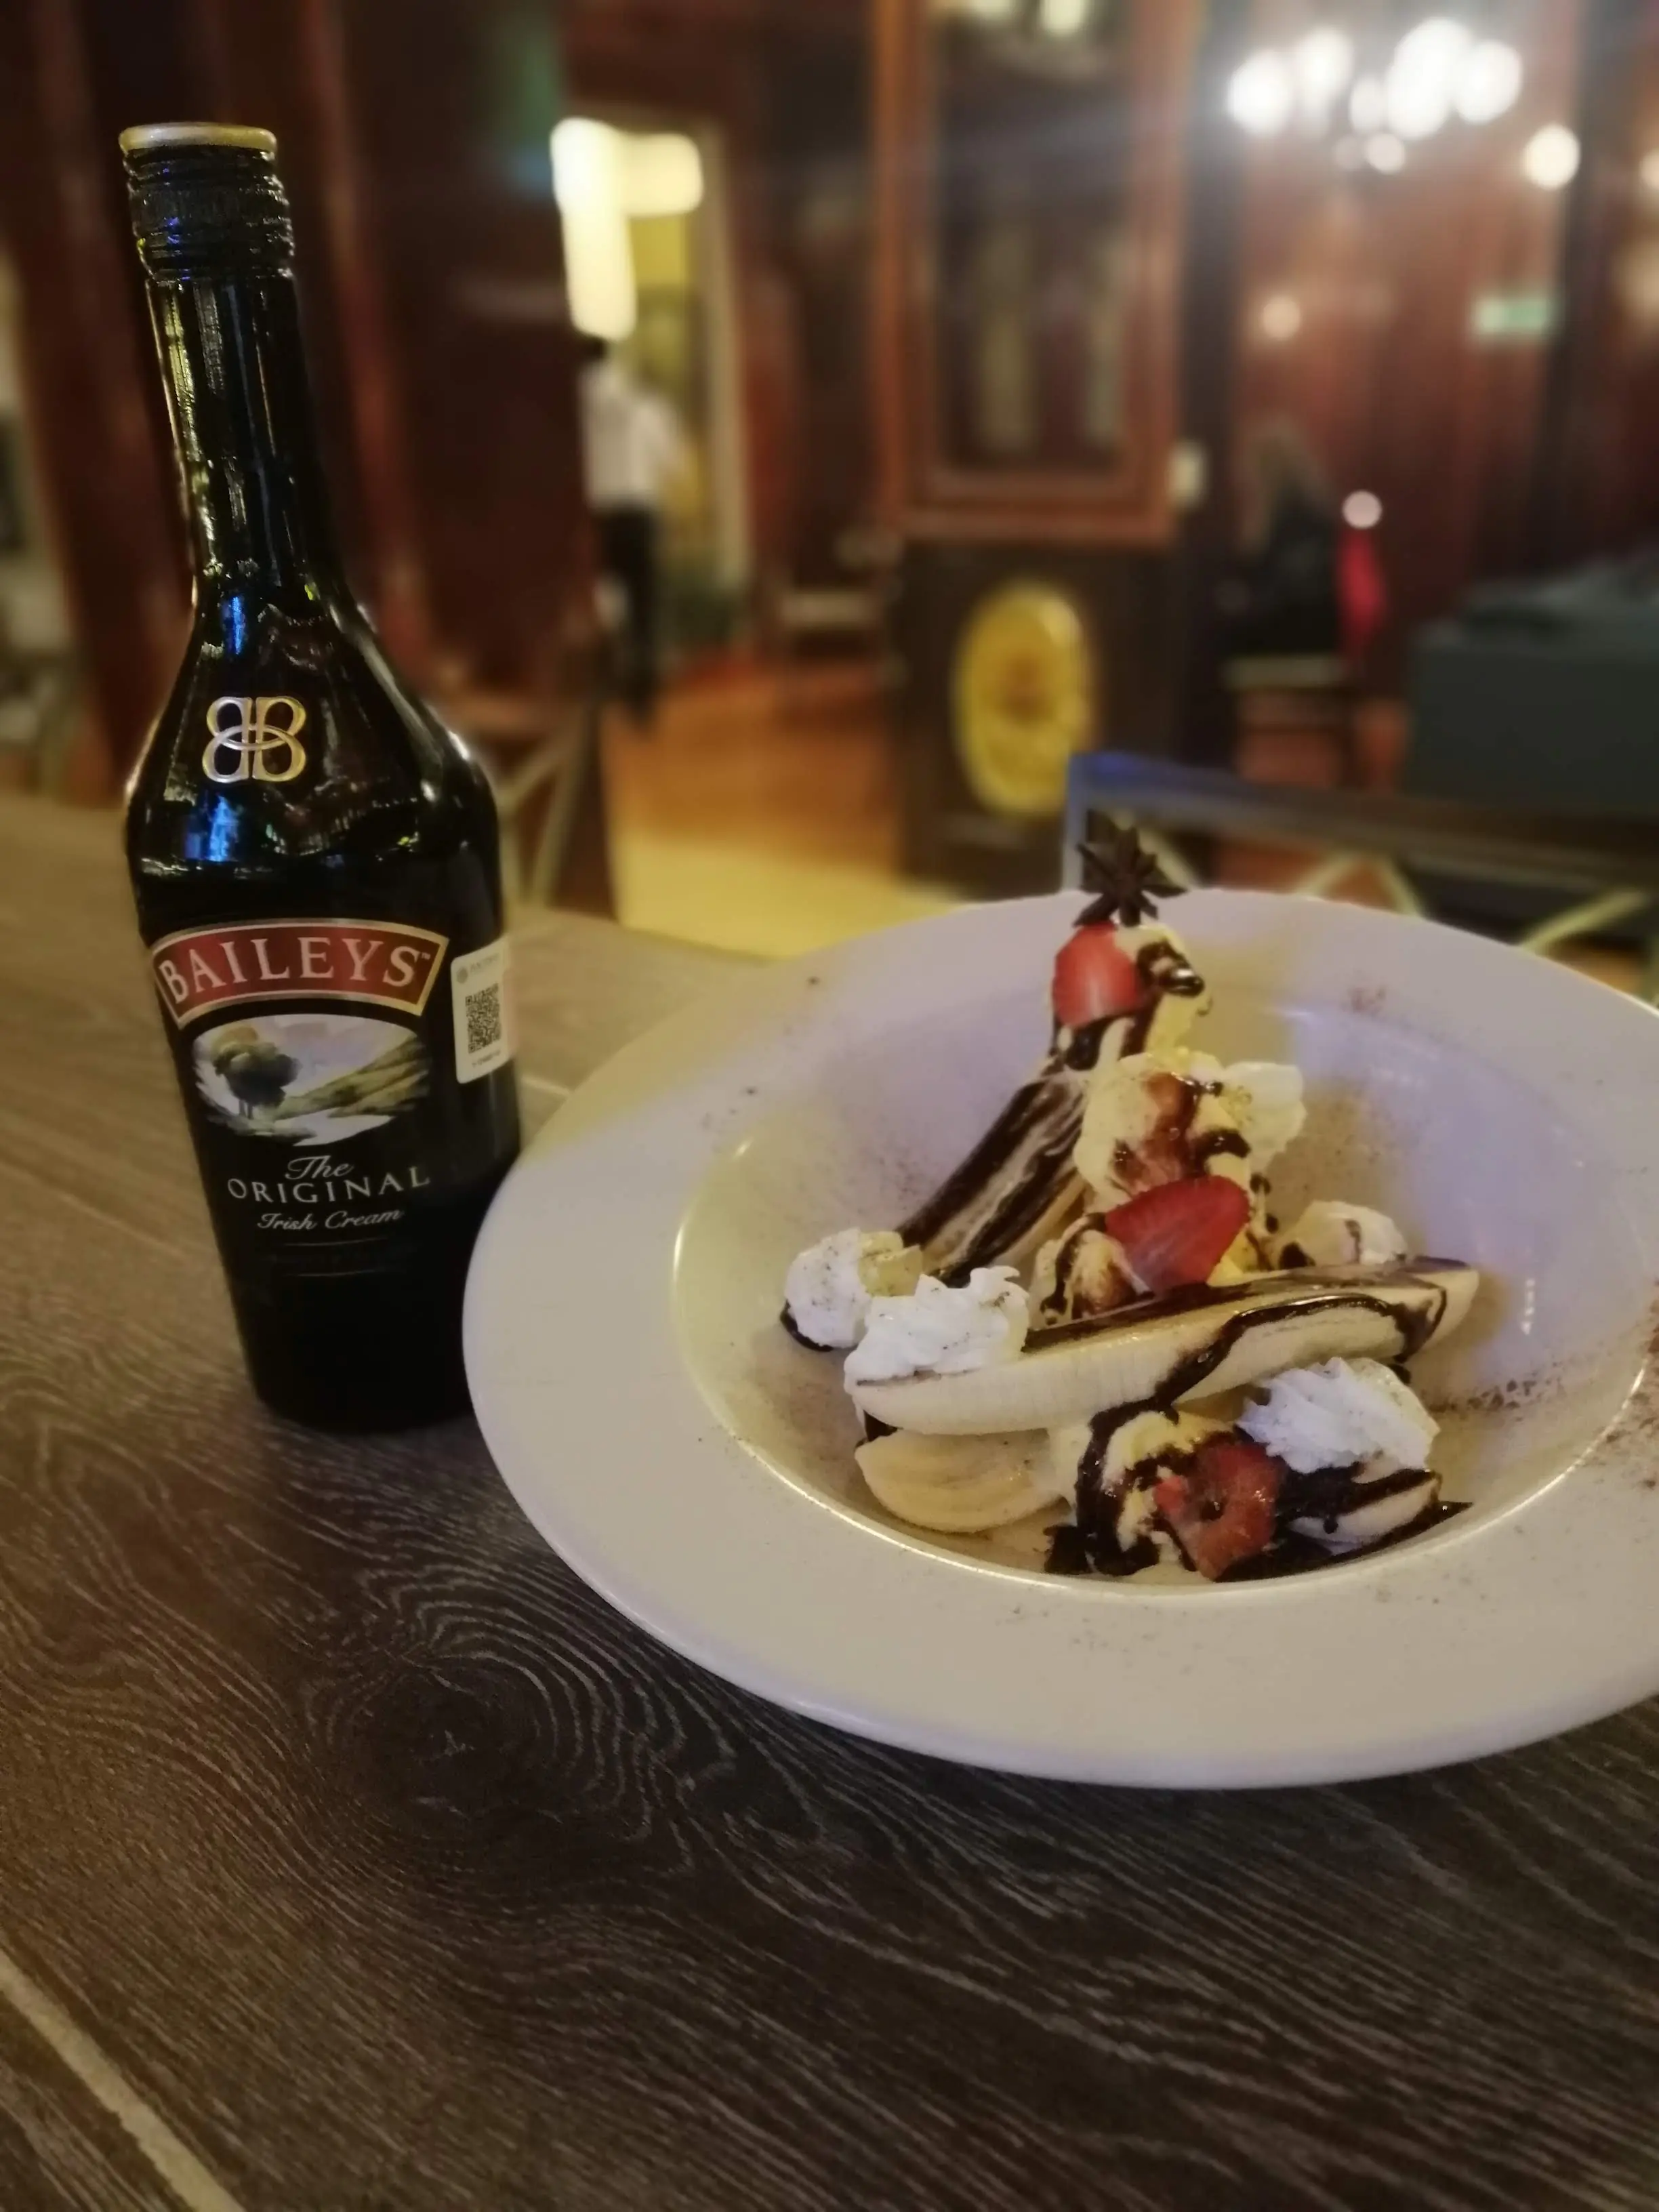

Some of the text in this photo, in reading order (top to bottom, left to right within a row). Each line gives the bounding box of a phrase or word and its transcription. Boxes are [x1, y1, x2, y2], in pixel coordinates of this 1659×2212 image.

[159, 936, 421, 1004] BAILEYS
[285, 1155, 354, 1180] The
[228, 1166, 431, 1203] ORIGINAL
[257, 1209, 405, 1230] Irish Cream
